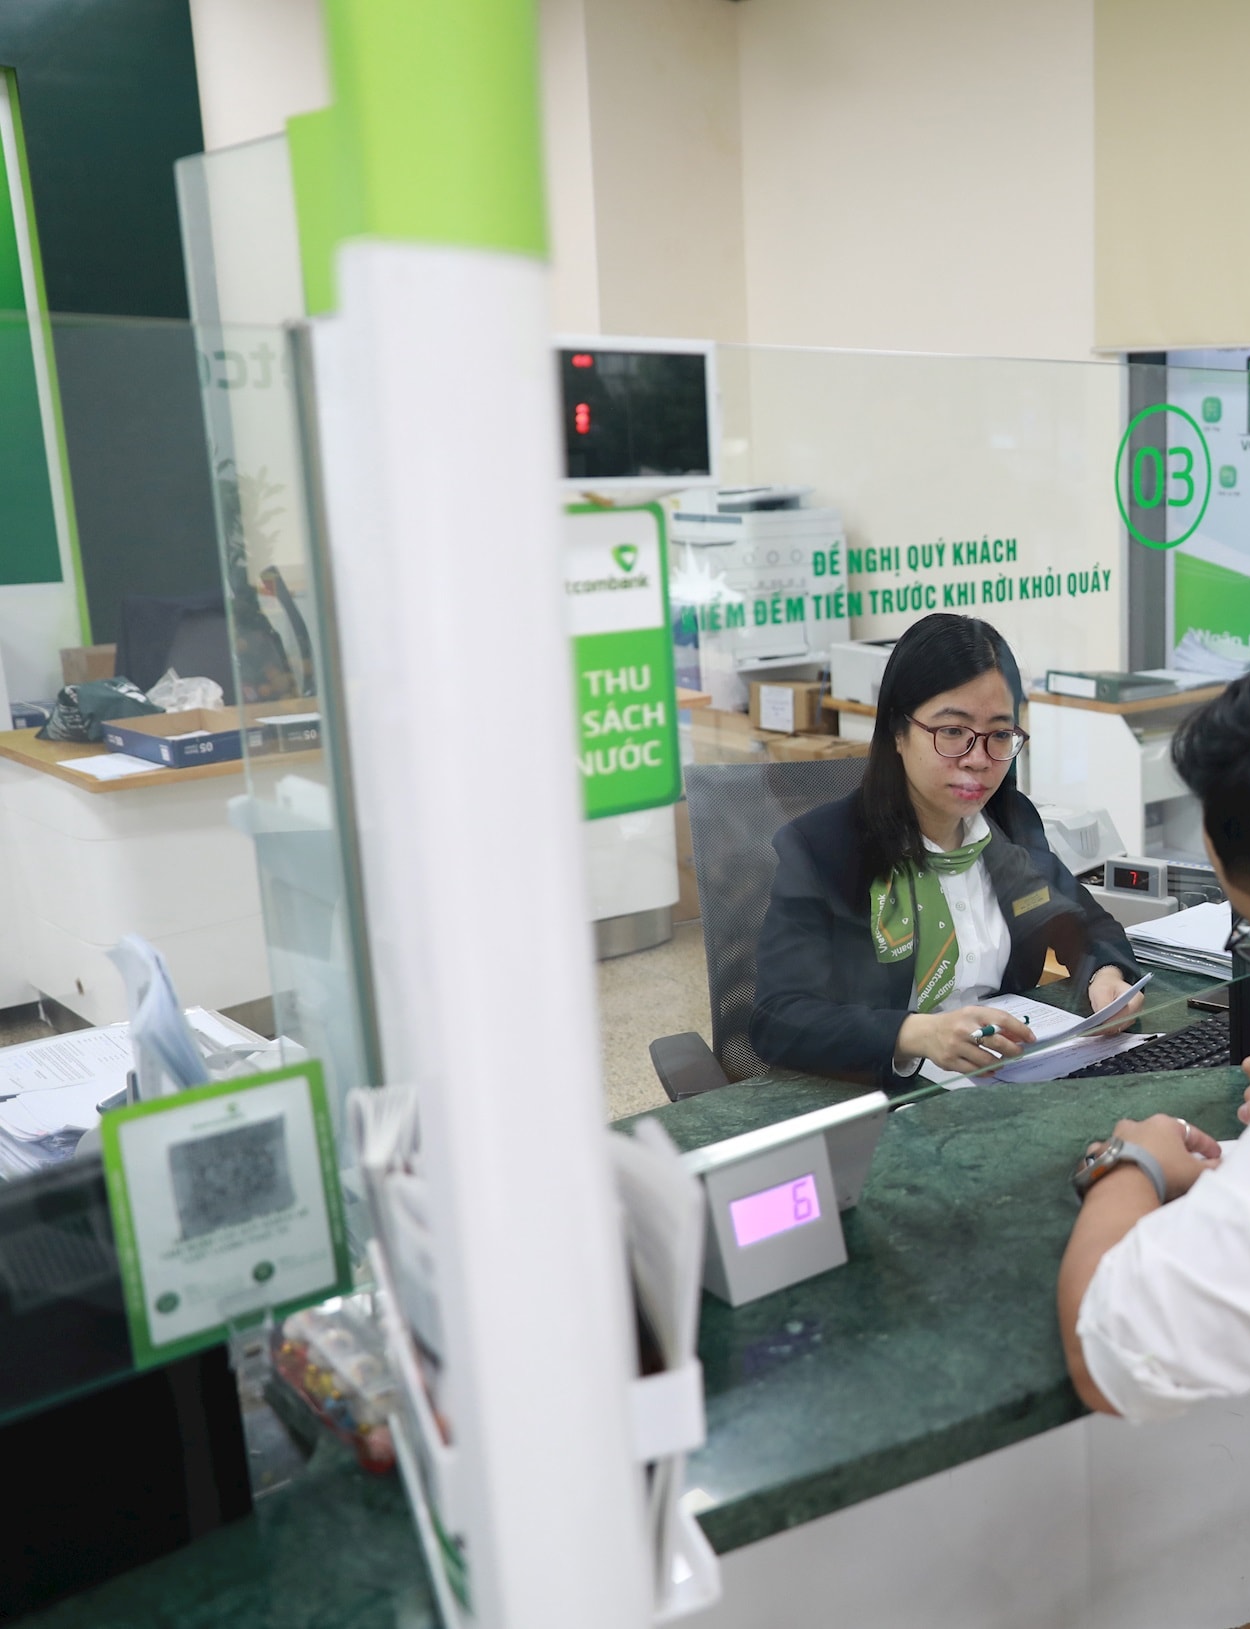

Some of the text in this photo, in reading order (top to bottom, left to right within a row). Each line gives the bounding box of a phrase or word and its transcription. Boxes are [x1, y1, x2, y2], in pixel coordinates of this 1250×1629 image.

[1133, 446, 1194, 508] 03
[848, 546, 900, 577] NGHỊ
[907, 537, 945, 571] QUÝ
[953, 534, 1017, 566] KHÁCH
[868, 580, 937, 615] TRƯỚC
[943, 581, 975, 607] KHI
[982, 572, 1013, 603] RỜI
[1020, 566, 1061, 600] KHỎI
[583, 664, 651, 696] THU
[582, 701, 666, 738] SÁCH
[1129, 871, 1137, 886] 7
[792, 1180, 812, 1221] 6
